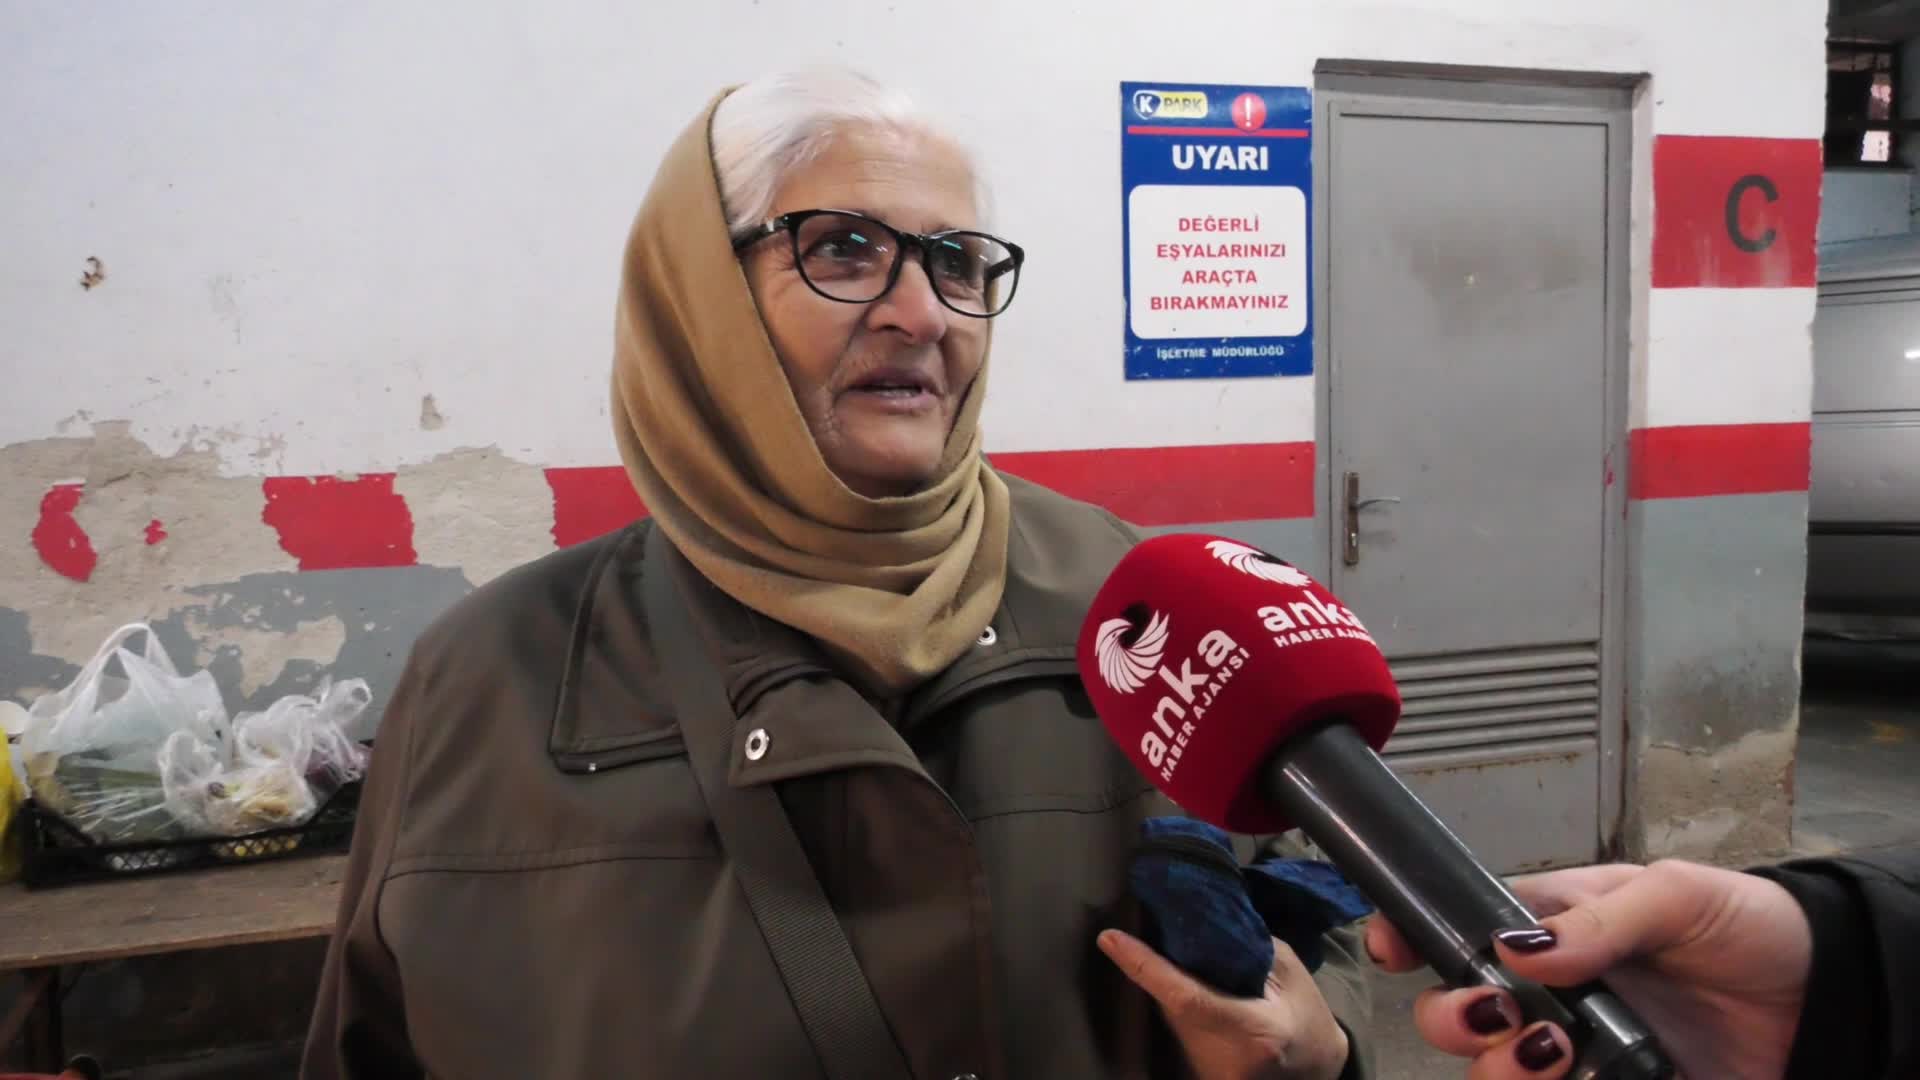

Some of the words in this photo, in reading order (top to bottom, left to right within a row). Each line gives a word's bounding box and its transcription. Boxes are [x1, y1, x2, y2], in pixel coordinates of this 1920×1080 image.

[1139, 95, 1153, 113] K
[1163, 97, 1203, 112] PARK
[1172, 144, 1268, 171] UYARI
[1178, 214, 1259, 232] DEĞERLİ
[1724, 174, 1779, 253] C
[1156, 243, 1286, 261] EŞYALARINIZI
[1182, 269, 1257, 287] ARAÇTA
[1150, 295, 1288, 311] BIRAKMAYINIZ
[1273, 627, 1335, 648] HABER
[1140, 629, 1238, 768] anka
[1160, 720, 1196, 783] HABER
[1192, 646, 1250, 721] AJANSI
